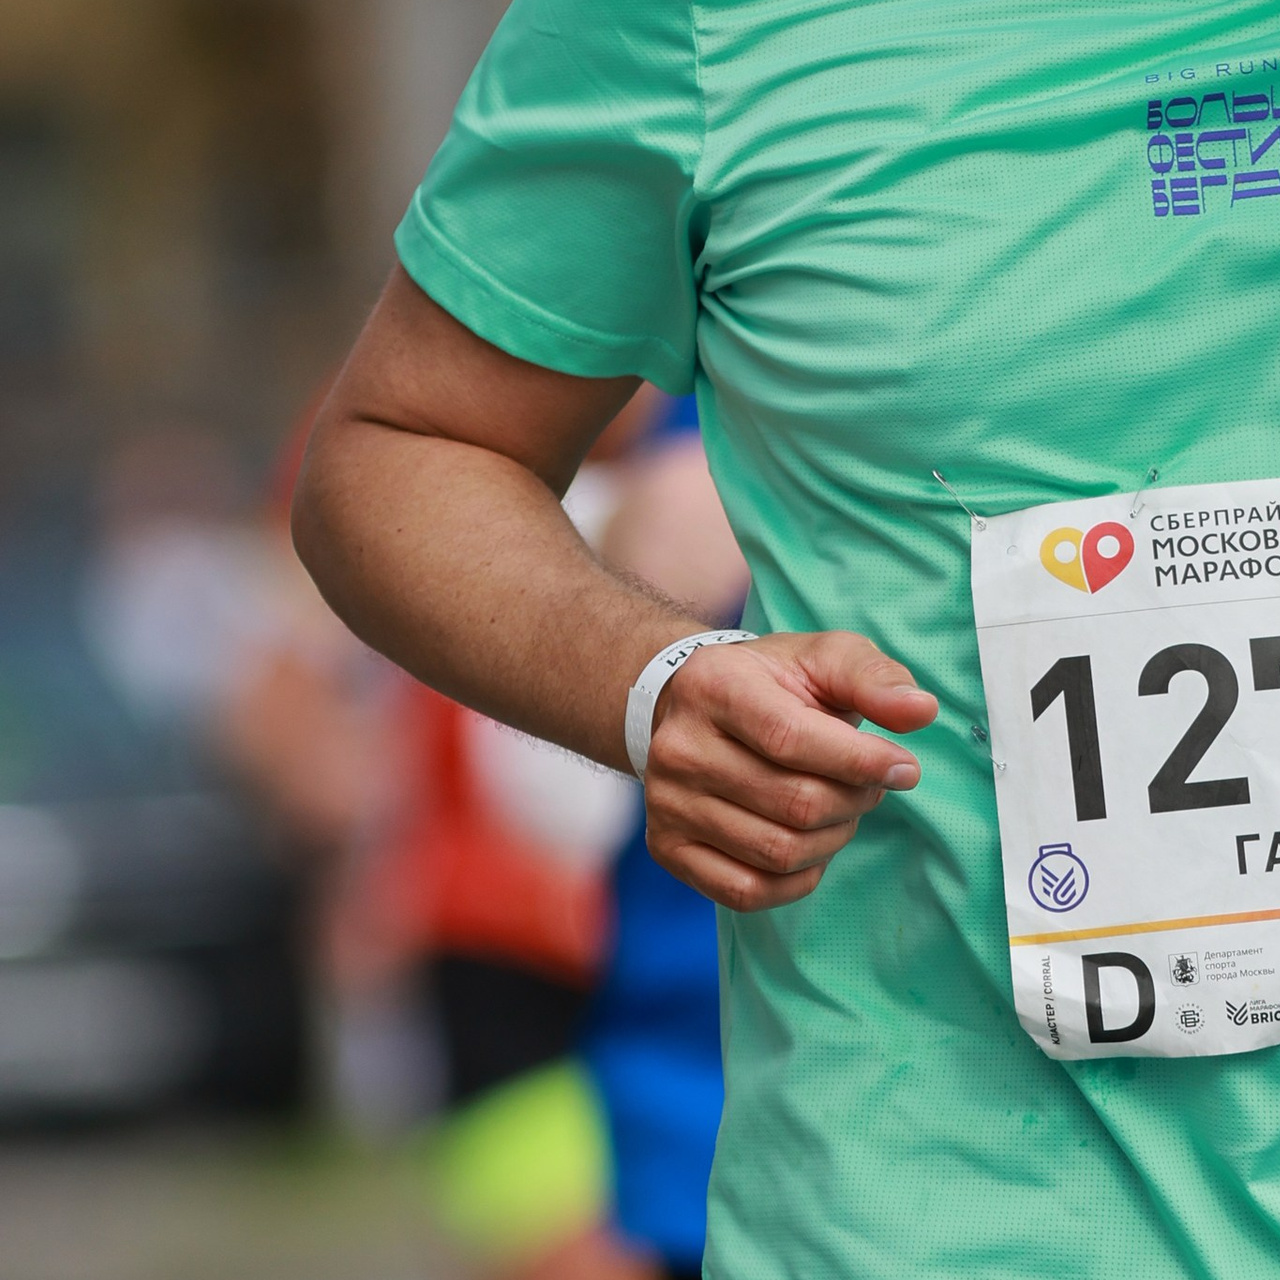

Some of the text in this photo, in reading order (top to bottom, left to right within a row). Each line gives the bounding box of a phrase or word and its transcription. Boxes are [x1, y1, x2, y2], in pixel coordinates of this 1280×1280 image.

[1145, 67, 1197, 84] BIG
[1215, 58, 1278, 78] RUN
[1203, 947, 1264, 961] Департамент
[1204, 961, 1236, 971] спорта
[1041, 955, 1054, 995] CORRAL
[1206, 968, 1275, 982] города Москвы
[1081, 951, 1156, 1044] D
[1045, 1003, 1061, 1046] КЛАСТЕР
